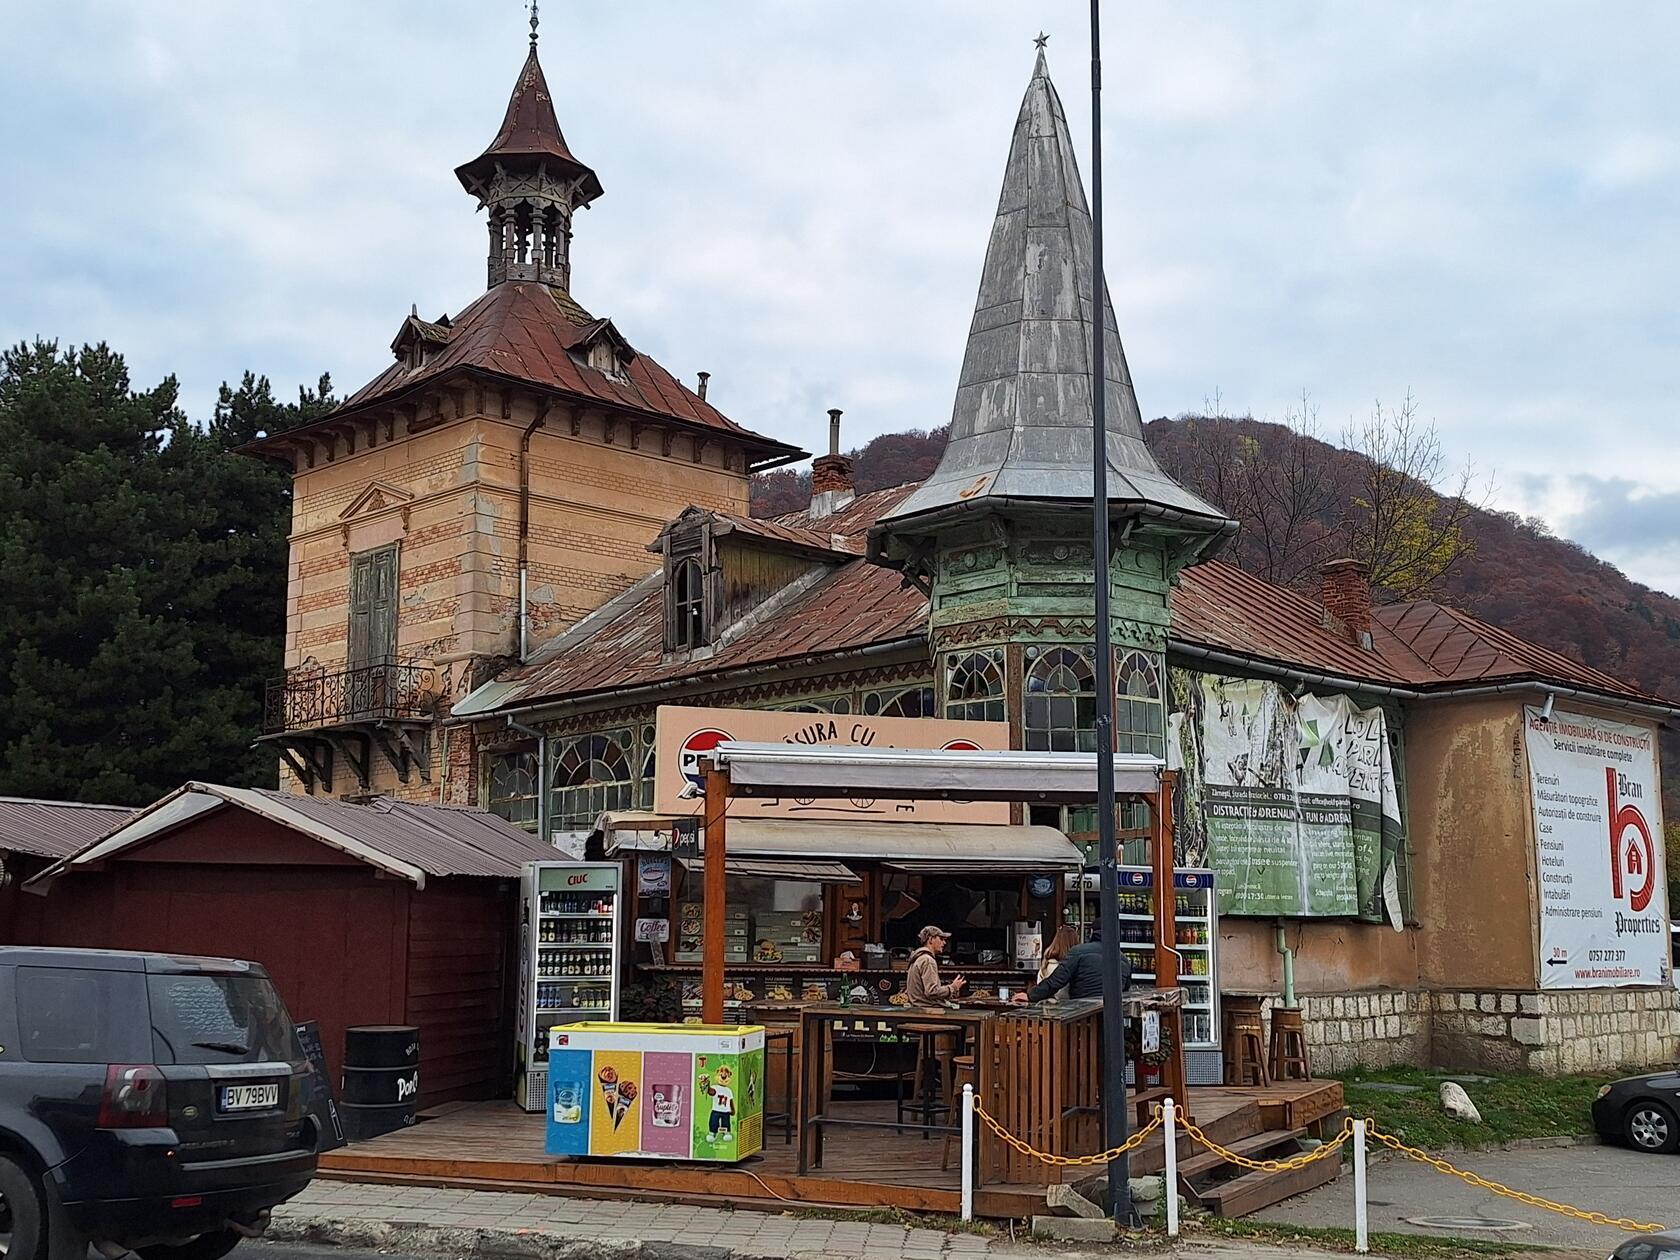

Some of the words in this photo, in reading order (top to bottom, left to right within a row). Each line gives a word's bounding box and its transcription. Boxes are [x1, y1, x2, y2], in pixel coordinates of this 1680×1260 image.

[851, 724, 876, 746] CU
[1604, 731, 1613, 744] DE
[1554, 738, 1576, 753] Servicii
[1577, 740, 1606, 758] imobiliare
[1607, 747, 1633, 763] complete
[1536, 773, 1560, 786] Terenuri
[1618, 773, 1643, 799] Bran
[1306, 812, 1318, 822] FUN
[1320, 813, 1324, 822] &
[1568, 809, 1576, 820] de
[1576, 810, 1602, 822] construire
[1539, 822, 1553, 834] Case
[680, 829, 696, 847] pepsi
[1540, 839, 1564, 851] Pensiuni
[1541, 855, 1565, 867] Hoteluri
[567, 874, 588, 886] CIUC
[1545, 905, 1580, 918] Administrare
[1581, 907, 1603, 919] pensiuni
[640, 921, 667, 933] Coffee
[1615, 912, 1661, 937] Properties
[1553, 947, 1560, 957] 30
[1589, 950, 1603, 961] 0757
[1604, 950, 1614, 961] 277
[1615, 950, 1625, 961] 377
[227, 1088, 242, 1106] BV
